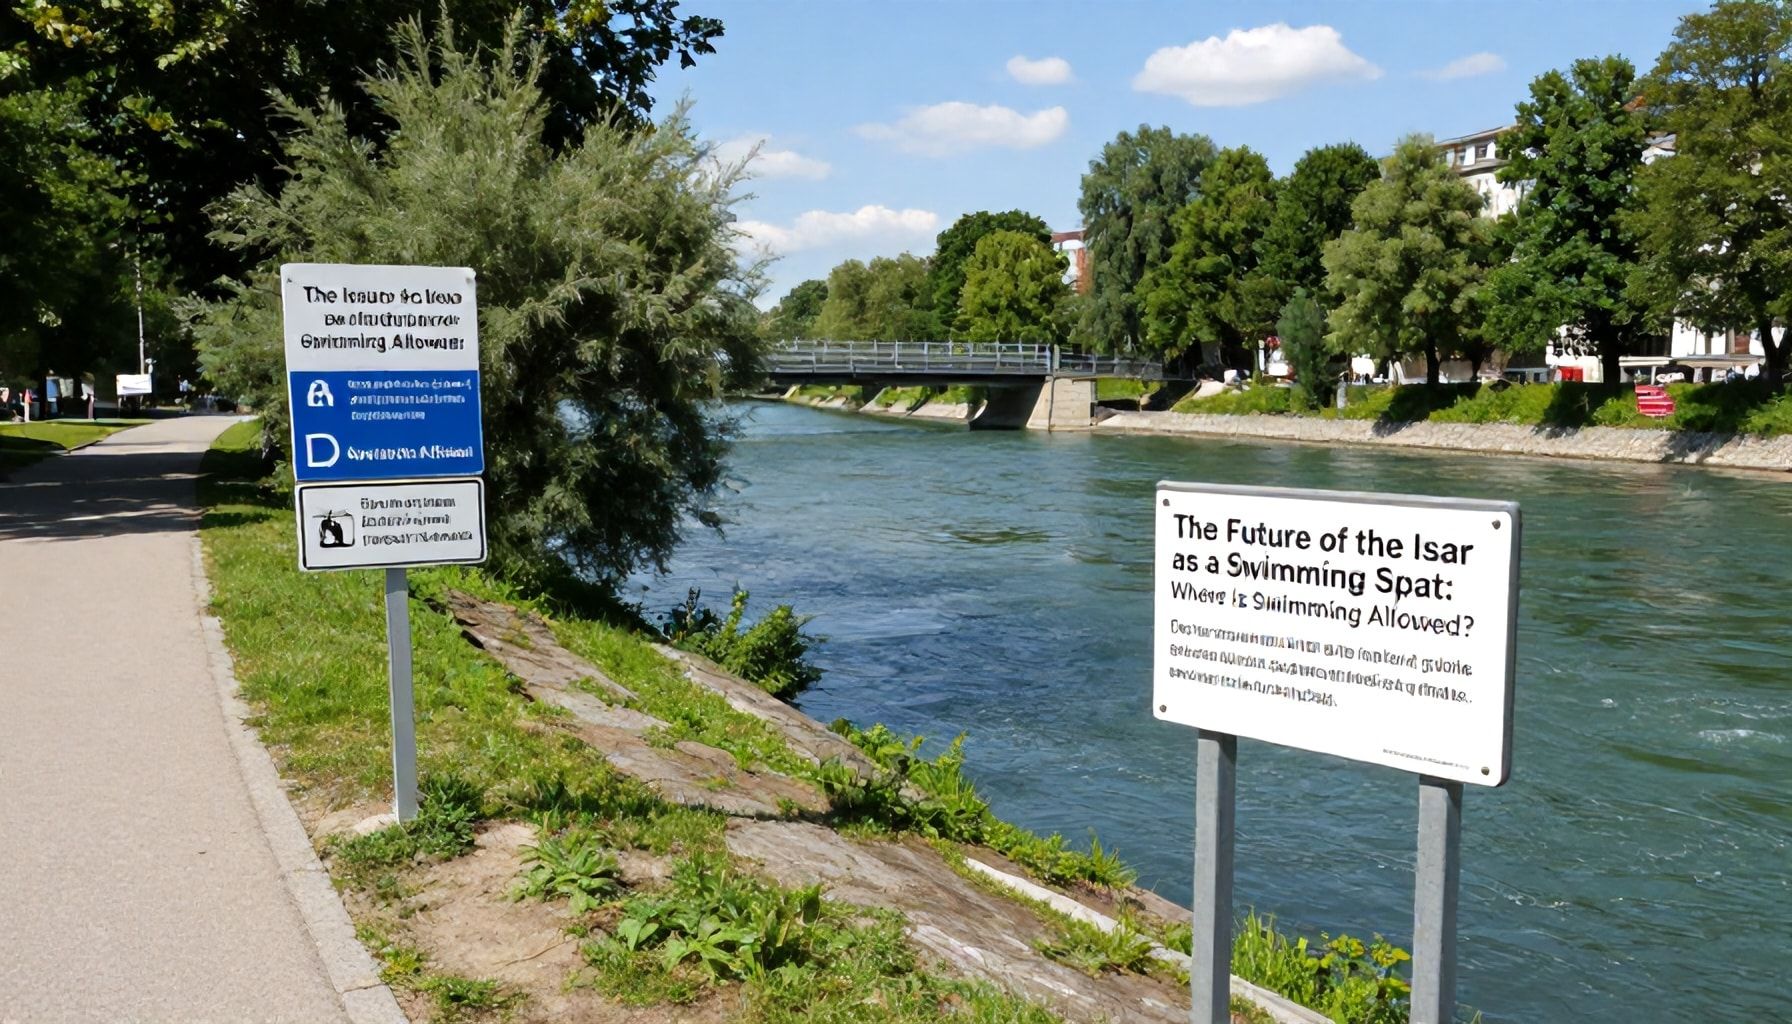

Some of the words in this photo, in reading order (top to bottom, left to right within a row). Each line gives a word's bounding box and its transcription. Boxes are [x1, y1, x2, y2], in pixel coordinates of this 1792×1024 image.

[303, 286, 337, 304] The
[305, 433, 340, 467] D
[1174, 513, 1218, 541] The
[1226, 518, 1311, 549] Future
[1319, 526, 1348, 554] of
[1356, 529, 1403, 559] the
[1414, 534, 1474, 565] Isar
[1173, 552, 1198, 572] as
[1205, 556, 1219, 575] a
[1227, 552, 1366, 596] Swimming
